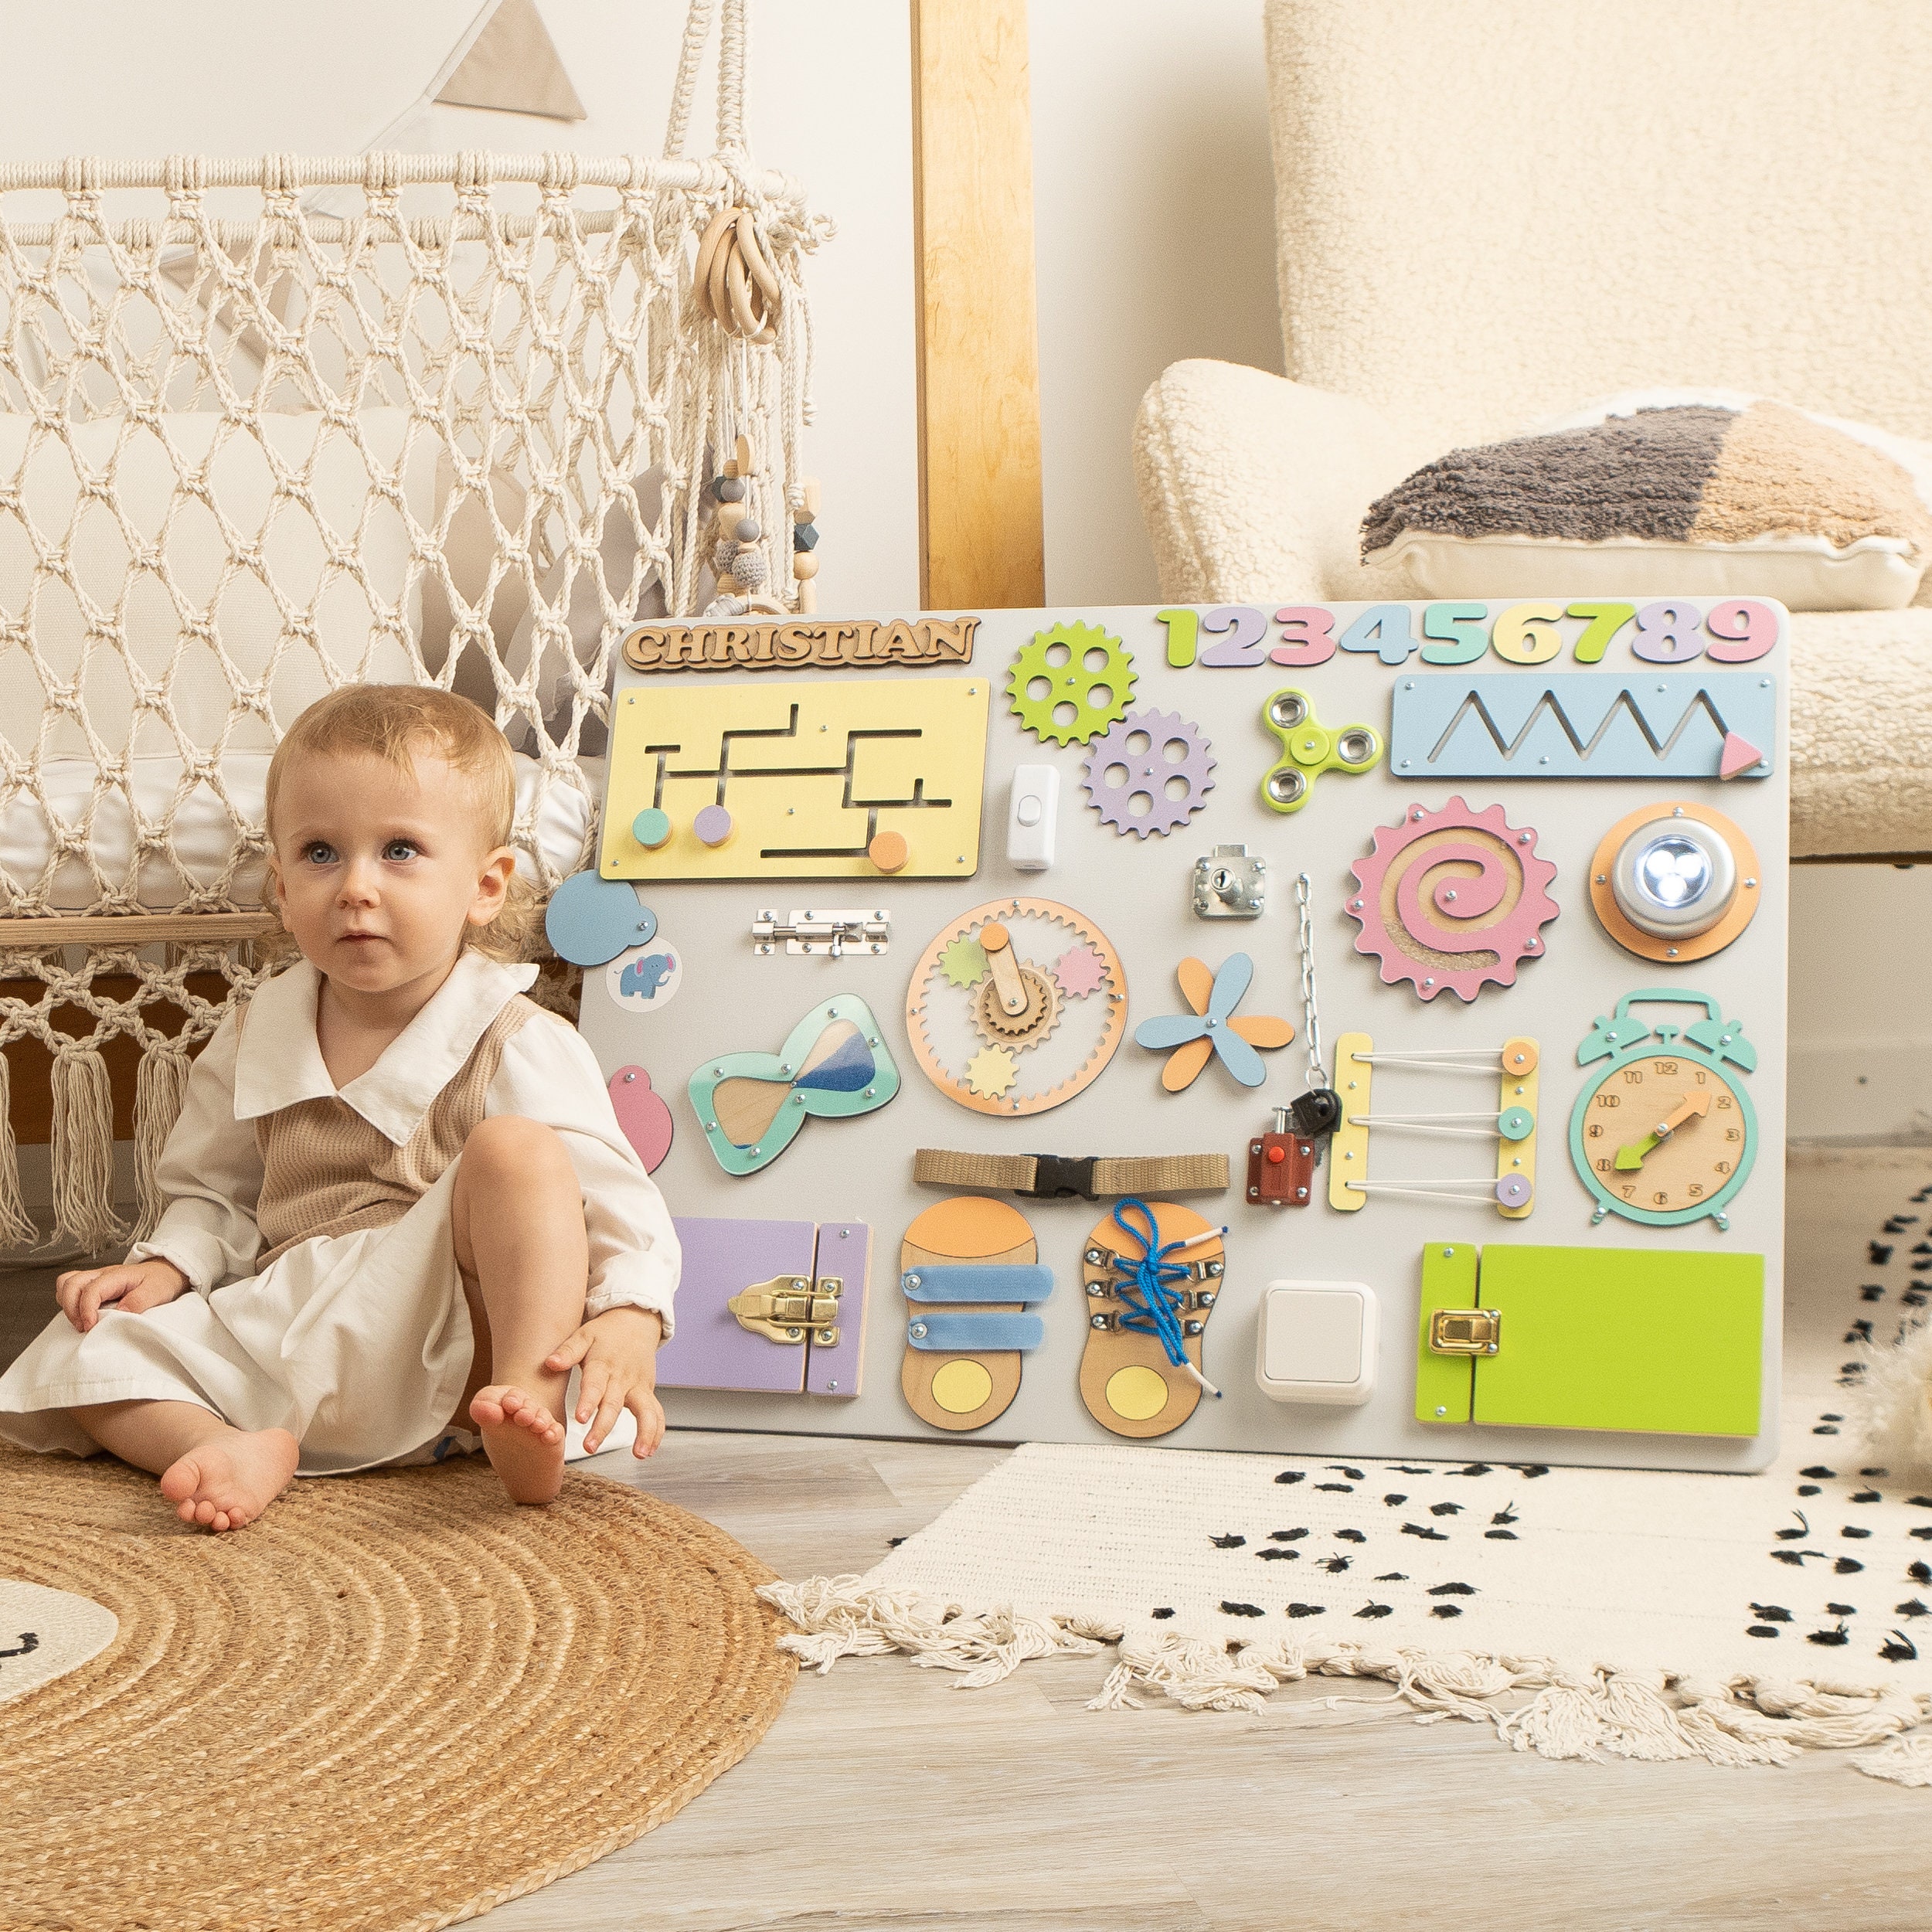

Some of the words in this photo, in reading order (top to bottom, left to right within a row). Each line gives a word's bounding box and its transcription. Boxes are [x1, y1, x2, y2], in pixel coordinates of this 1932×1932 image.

[625, 616, 981, 665] CHRISTIAN
[1655, 1061, 1679, 1075] 12
[1624, 1070, 1643, 1083] 11
[1696, 1071, 1706, 1084] 1
[1596, 1094, 1621, 1107] 10
[1717, 1096, 1731, 1109] 2
[1589, 1124, 1604, 1138] 9
[1726, 1128, 1740, 1141] 3
[1597, 1158, 1611, 1172] 8
[1714, 1161, 1730, 1175] 4
[1622, 1185, 1636, 1198] 7
[1689, 1183, 1703, 1197] 5
[1653, 1192, 1668, 1205] 6
